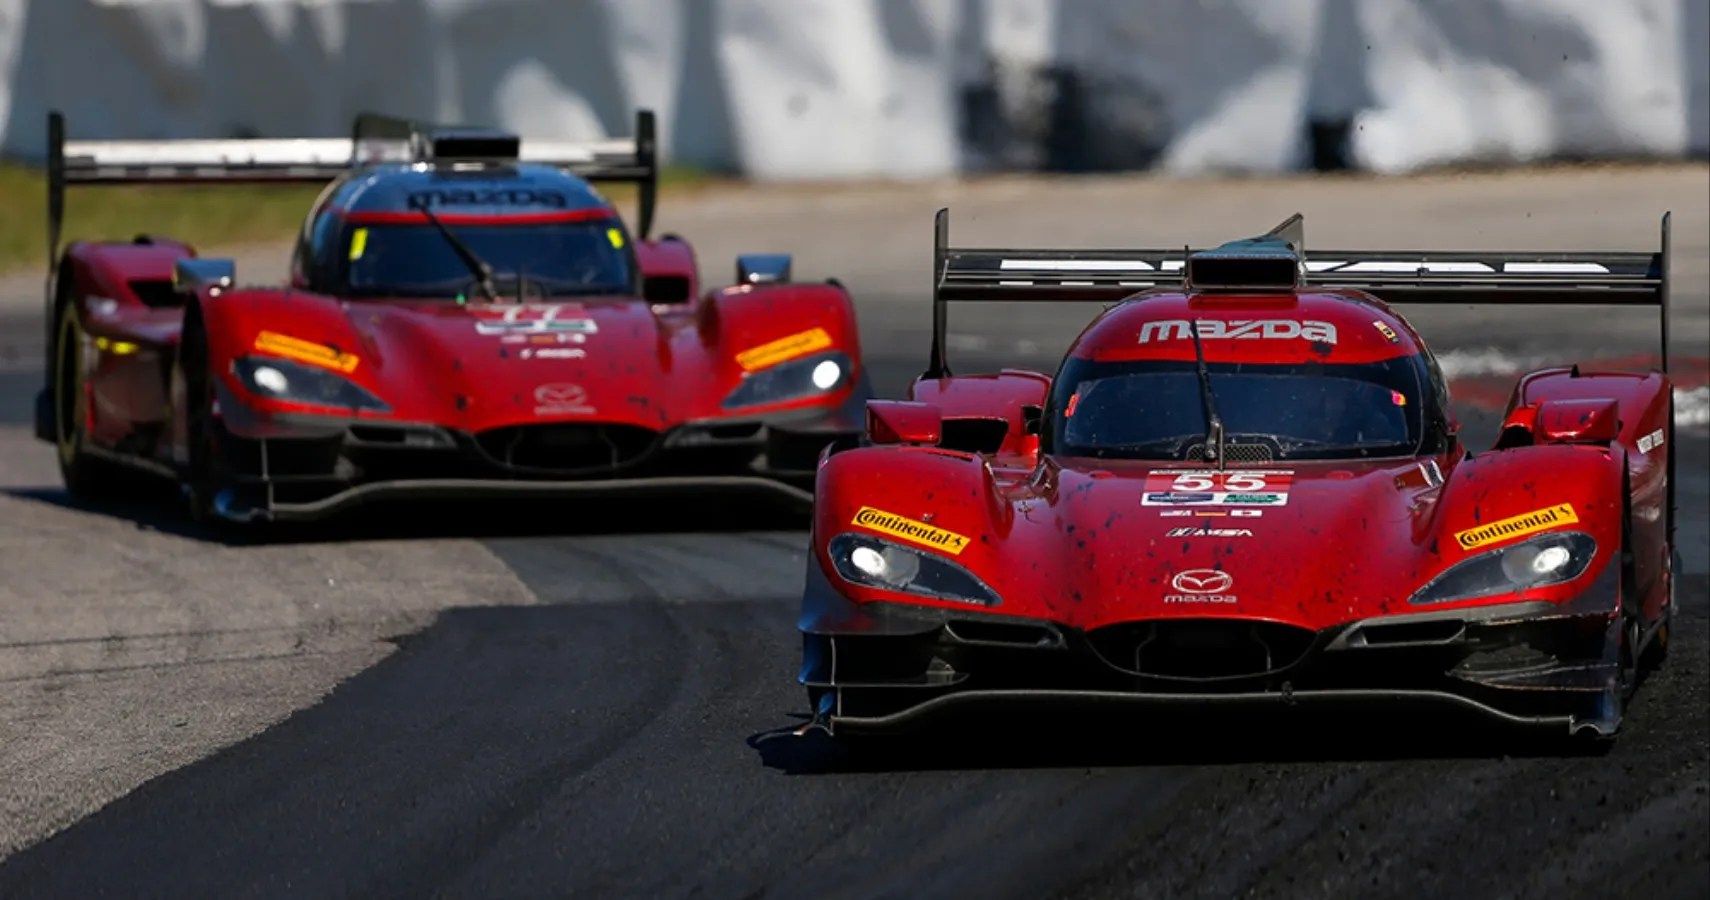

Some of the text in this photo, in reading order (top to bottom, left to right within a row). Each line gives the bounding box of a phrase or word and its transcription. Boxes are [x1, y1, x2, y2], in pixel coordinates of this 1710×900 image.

[1172, 474, 1266, 491] 55
[856, 509, 951, 545] Continental
[1459, 509, 1558, 546] Continental
